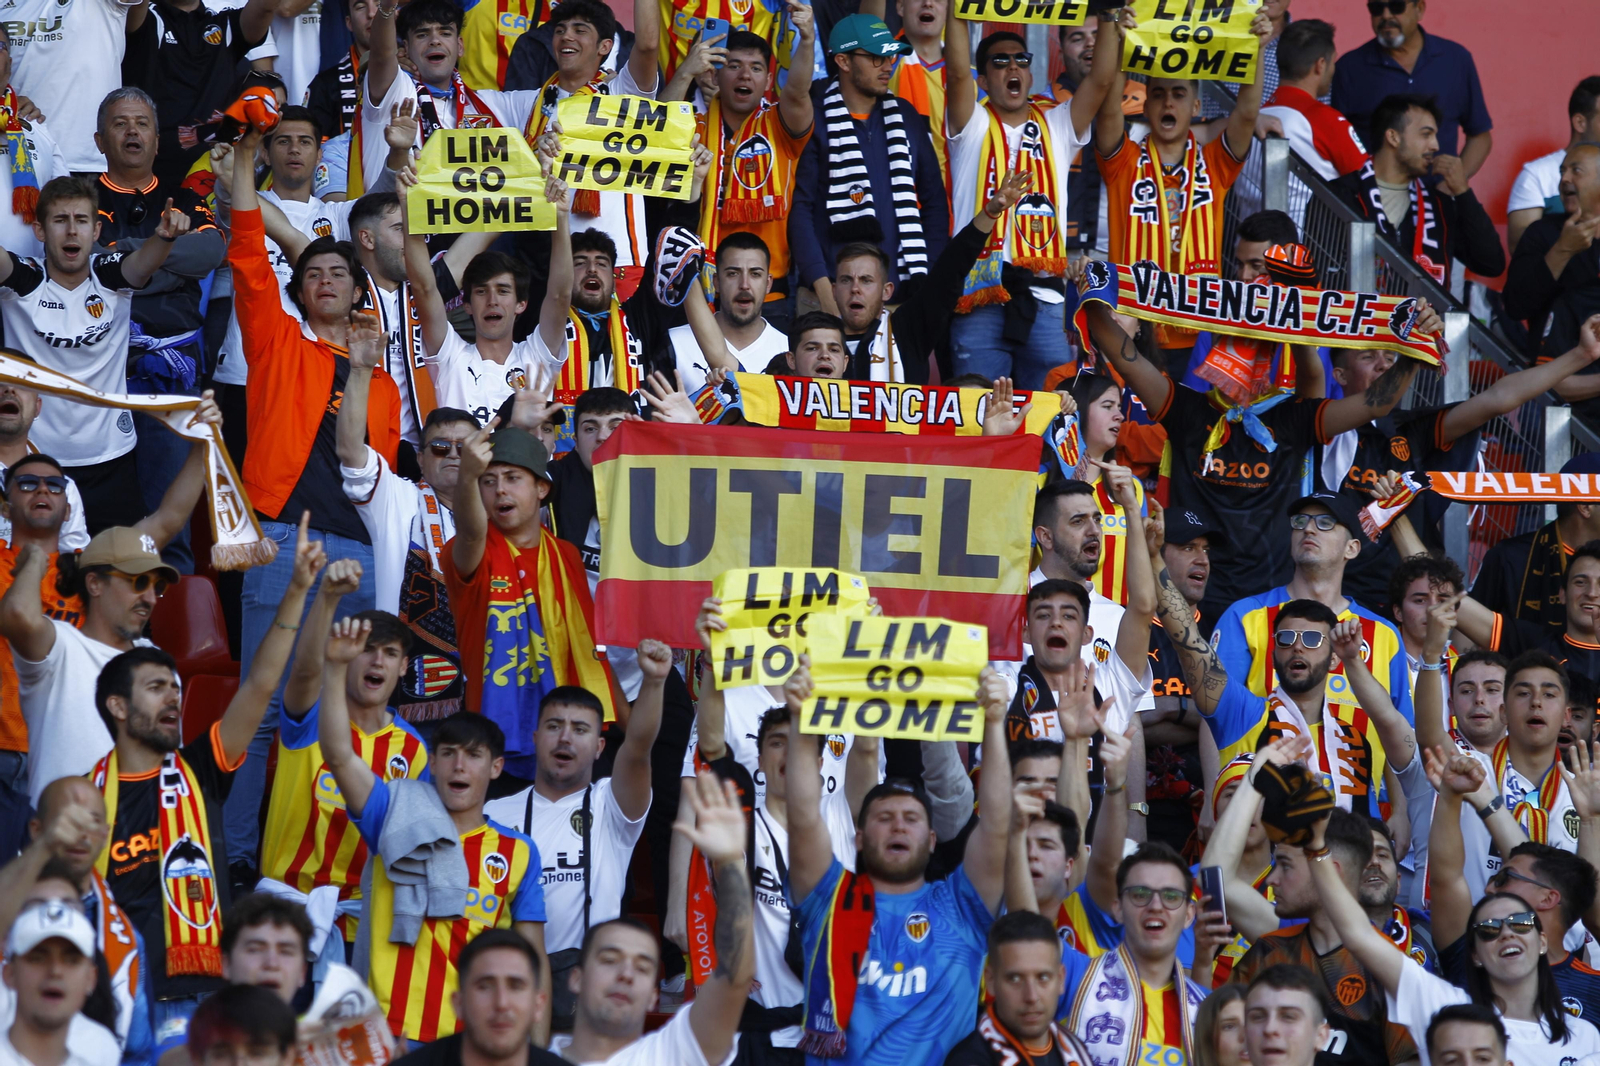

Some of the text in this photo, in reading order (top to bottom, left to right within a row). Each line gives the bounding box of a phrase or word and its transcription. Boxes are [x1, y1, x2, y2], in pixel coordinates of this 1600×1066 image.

[960, 0, 1081, 20] HOME
[1153, 0, 1235, 23] LIM
[1170, 25, 1214, 44] GO
[1128, 45, 1254, 78] HOME
[586, 96, 668, 132] LIM
[447, 135, 509, 164] LIM
[602, 131, 648, 155] GO
[452, 166, 506, 192] GO
[558, 152, 690, 193] HOME
[427, 196, 534, 226] HOME
[1130, 268, 1379, 337] VALENCIA C.F.
[776, 379, 963, 427] VALENCIA
[1441, 471, 1600, 495] VALEN
[629, 467, 1000, 579] UTIEL
[744, 572, 840, 610] LIM
[842, 620, 953, 661] LIM
[722, 644, 796, 683] HO
[866, 665, 924, 693] GO
[809, 696, 980, 735] HOME
